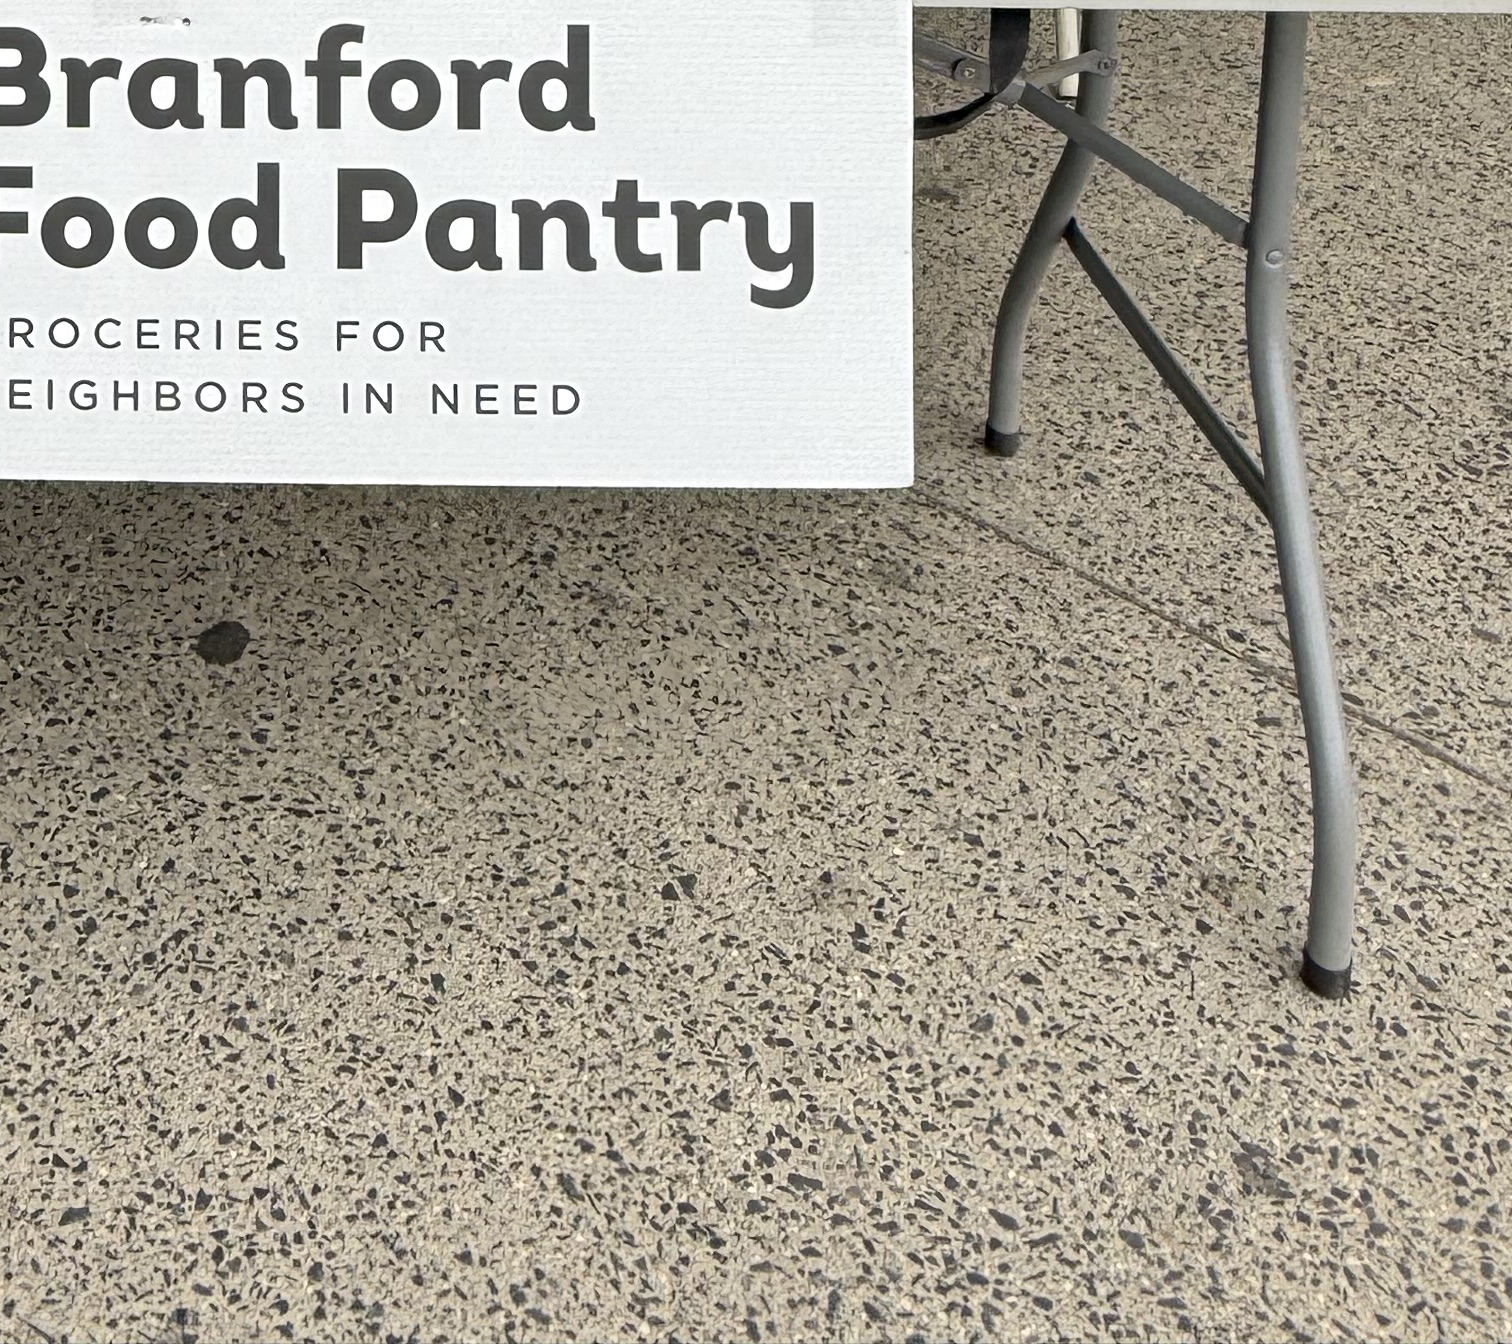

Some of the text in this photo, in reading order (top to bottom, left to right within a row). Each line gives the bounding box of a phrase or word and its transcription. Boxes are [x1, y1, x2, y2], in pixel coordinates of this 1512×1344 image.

[336, 168, 814, 309] Pantry
[336, 320, 446, 353] FOR
[342, 382, 393, 414] IN
[432, 383, 580, 415] NEED
